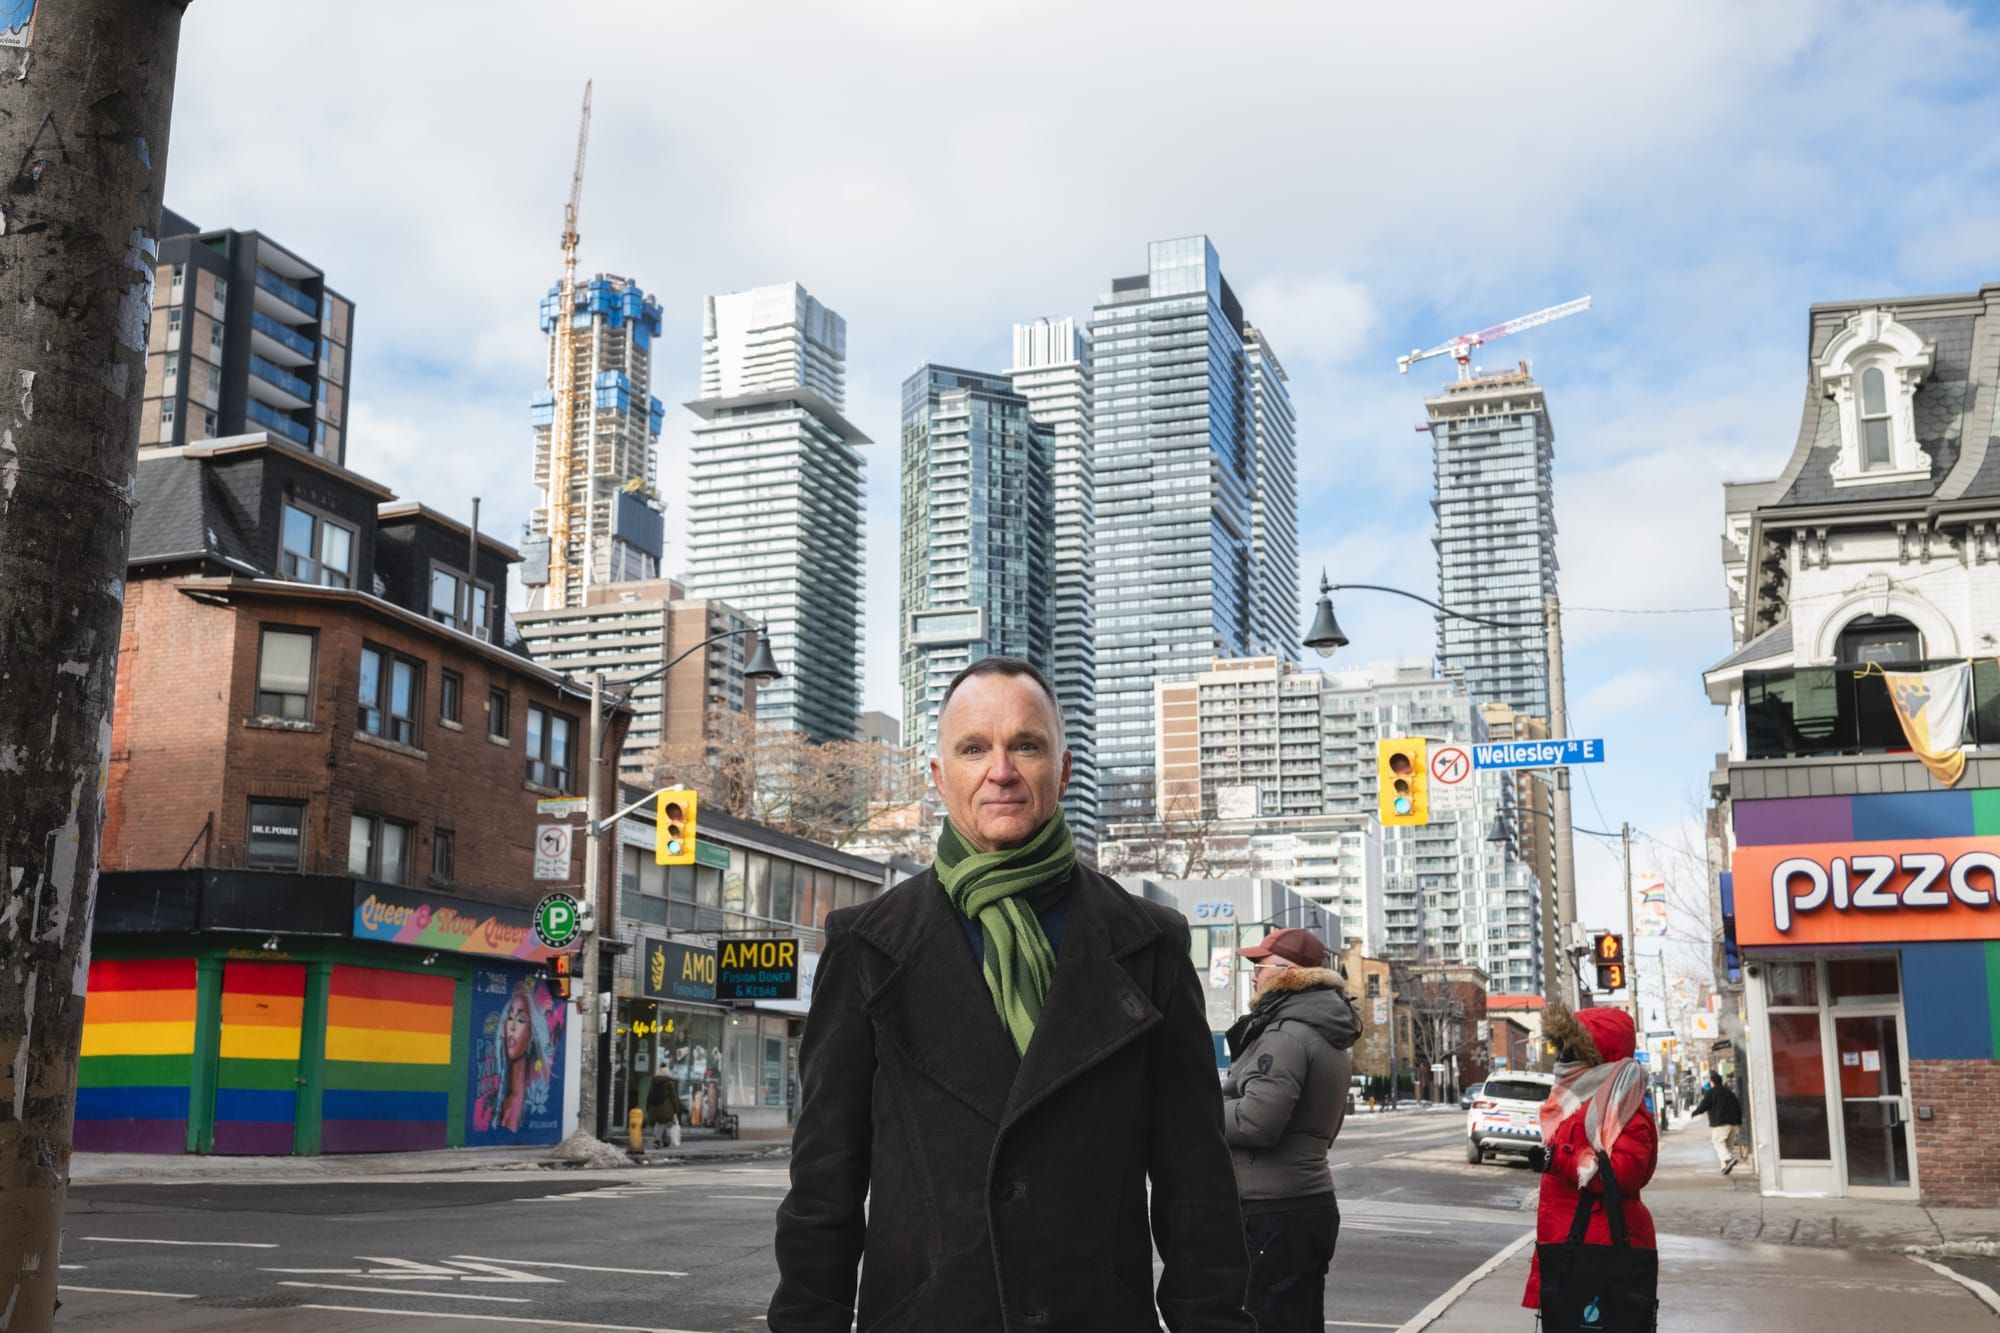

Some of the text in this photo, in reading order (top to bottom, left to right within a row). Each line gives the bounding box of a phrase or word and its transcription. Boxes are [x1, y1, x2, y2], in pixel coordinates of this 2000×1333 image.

[1477, 740, 1594, 764] Wellesley St E
[1771, 851, 2000, 932] pizza
[361, 893, 415, 931] Queer
[416, 903, 432, 930] &
[436, 907, 478, 937] Now
[484, 914, 529, 949] Queer
[549, 907, 569, 930] P
[682, 950, 715, 985] AMO
[720, 941, 794, 968] AMOR
[1610, 965, 1621, 987] 3
